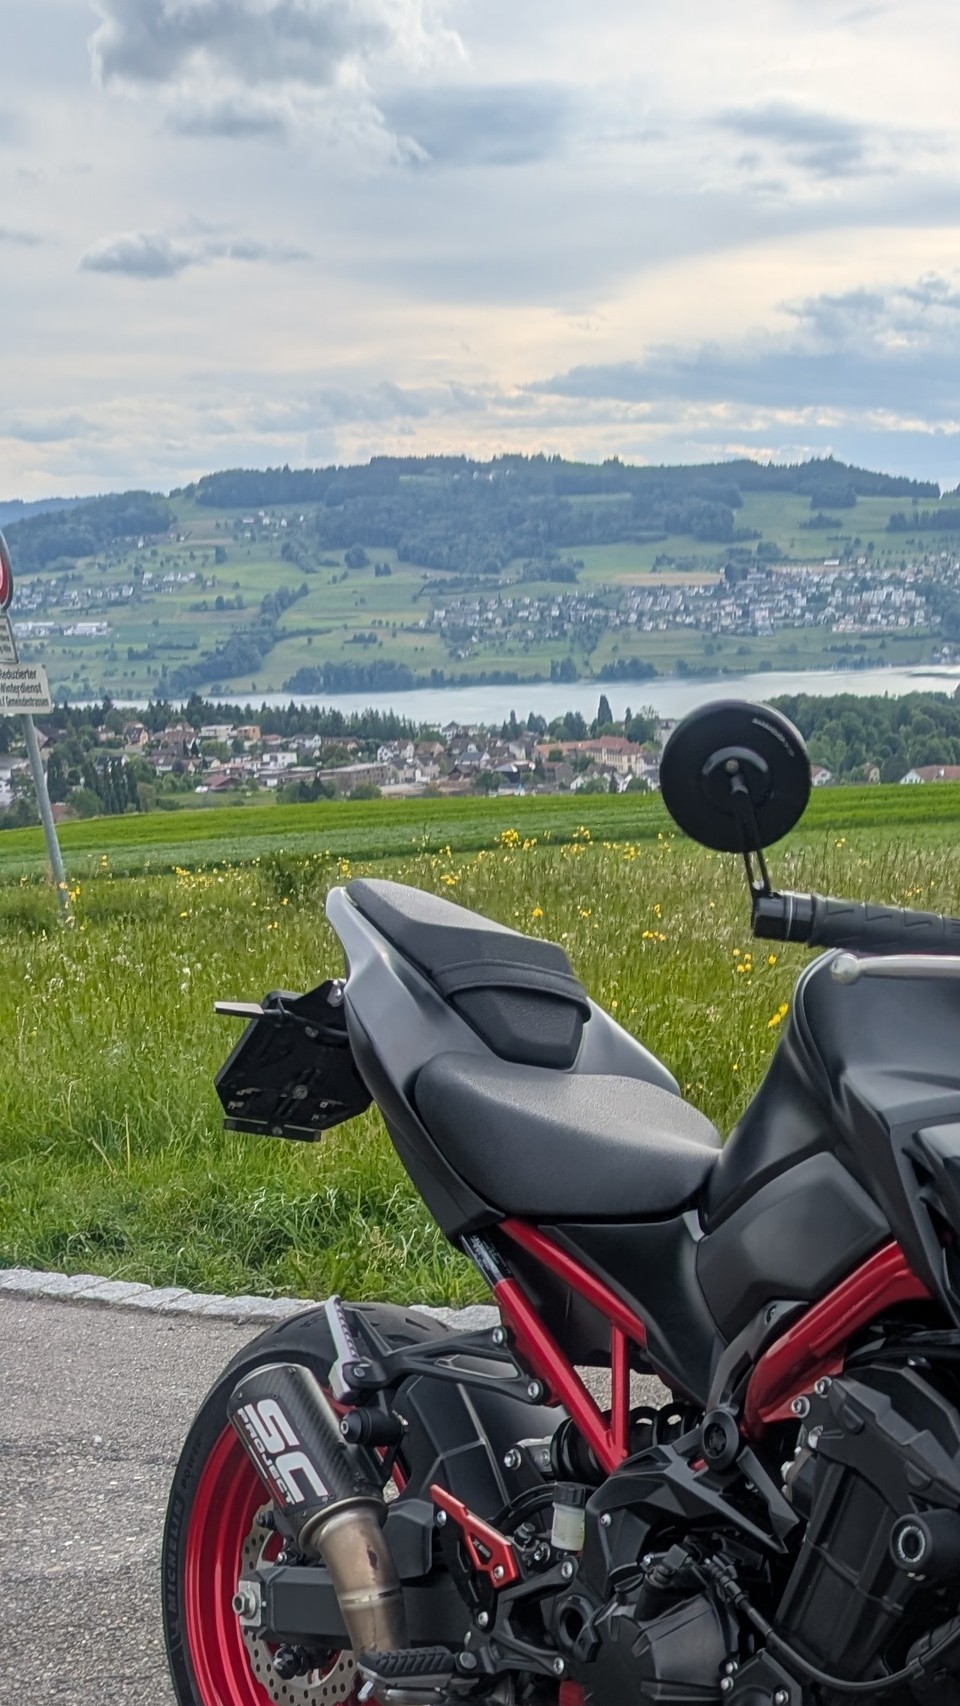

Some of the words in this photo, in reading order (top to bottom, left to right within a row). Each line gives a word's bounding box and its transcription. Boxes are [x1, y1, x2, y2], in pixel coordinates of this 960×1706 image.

[237, 1407, 296, 1505] PROJECT
[244, 1399, 329, 1503] SC
[167, 1500, 184, 1614] MICHELIN
